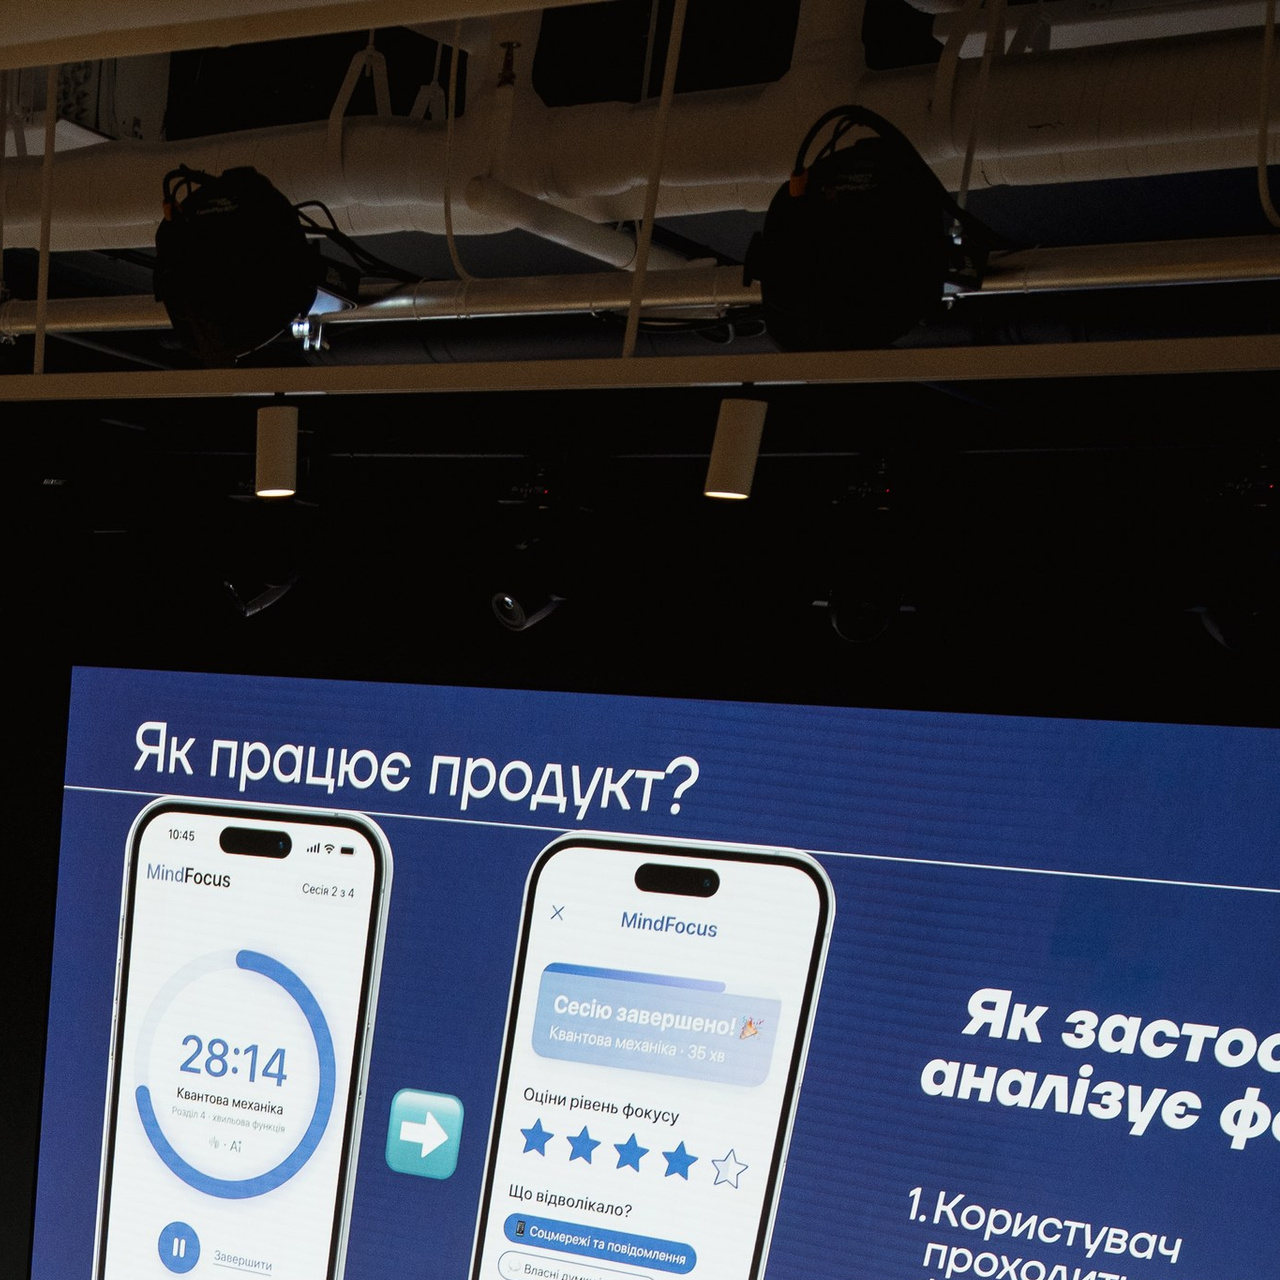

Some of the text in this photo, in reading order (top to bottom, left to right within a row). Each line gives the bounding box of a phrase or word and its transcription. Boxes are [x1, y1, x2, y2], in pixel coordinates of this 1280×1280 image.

[134, 721, 700, 820] Як працює продукт?
[168, 828, 195, 842] 10:45
[146, 863, 231, 888] MindFocus
[302, 883, 329, 897] Сесія
[331, 886, 338, 897] 2
[347, 888, 355, 898] 4
[621, 911, 718, 938] MindFocus
[554, 995, 737, 1036] Сесію завершено!
[962, 988, 1049, 1043] Як
[179, 1034, 287, 1087] 28:14
[549, 1025, 725, 1063] Квантова механіка 35 хв
[176, 1087, 283, 1115] Квантова механіка
[523, 1087, 680, 1127] Оціни рівень фокусу
[920, 1058, 1280, 1150] аналізує ф
[509, 1184, 633, 1218] Що відволікало?
[529, 1225, 686, 1265] Соцмережі та повідомлення
[933, 1191, 1183, 1264] Користувач
[214, 1250, 273, 1271] Завершити
[523, 1263, 560, 1280] Власні
